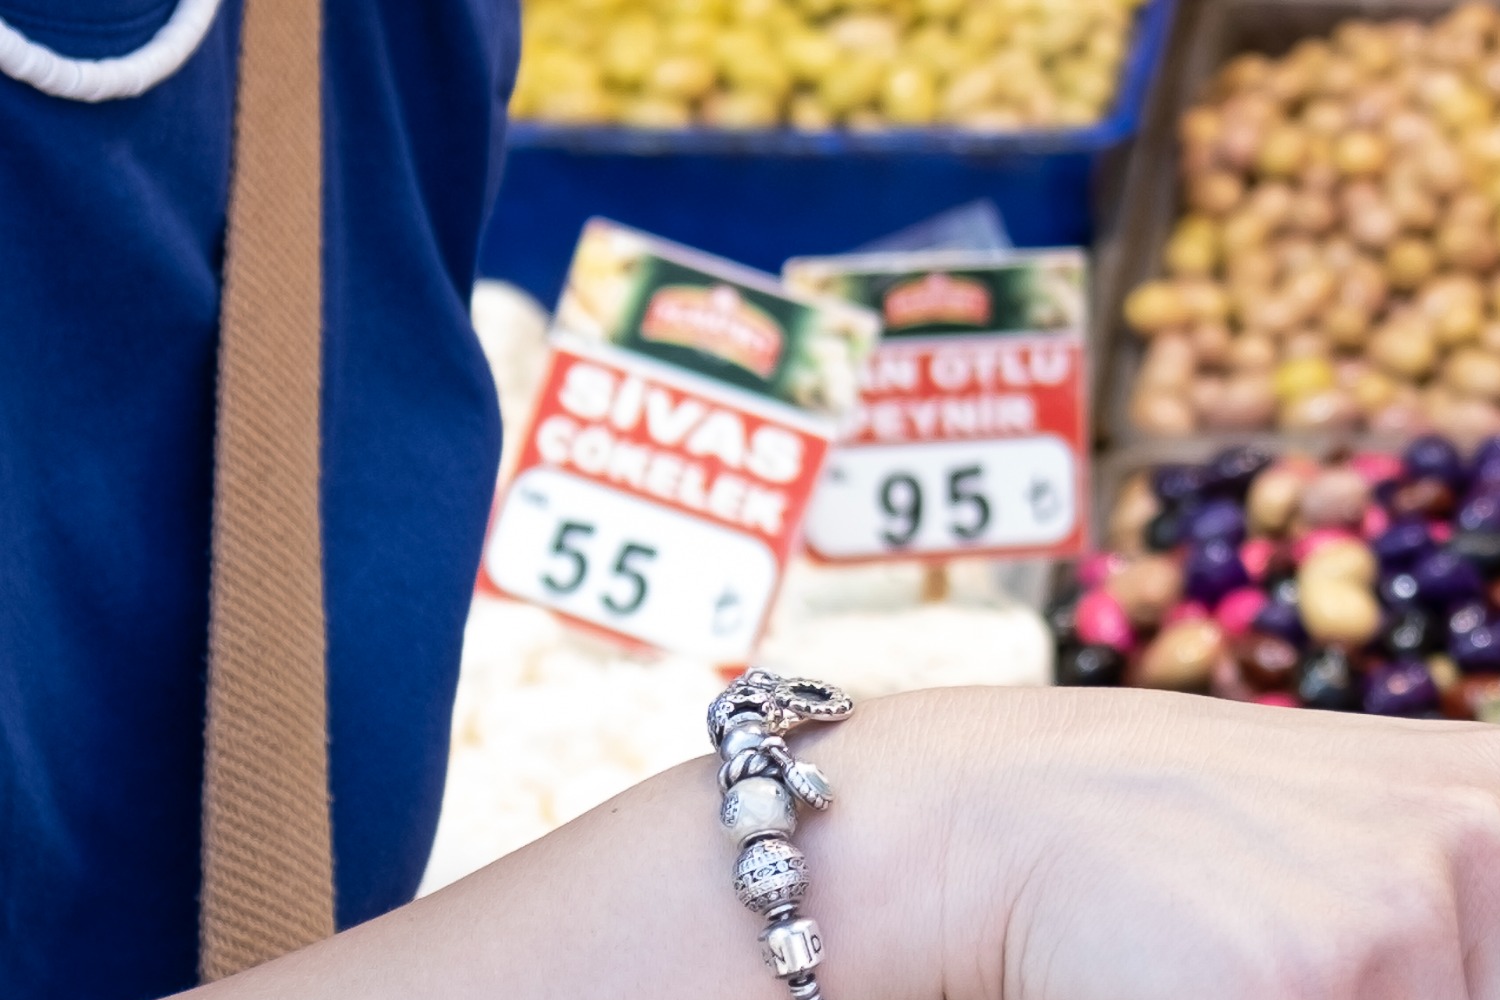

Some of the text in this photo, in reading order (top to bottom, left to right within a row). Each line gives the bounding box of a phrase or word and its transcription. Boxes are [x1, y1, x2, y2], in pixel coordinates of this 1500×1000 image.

[558, 358, 804, 486] SİVAS
[878, 463, 993, 547] 95
[540, 521, 659, 617] 55
